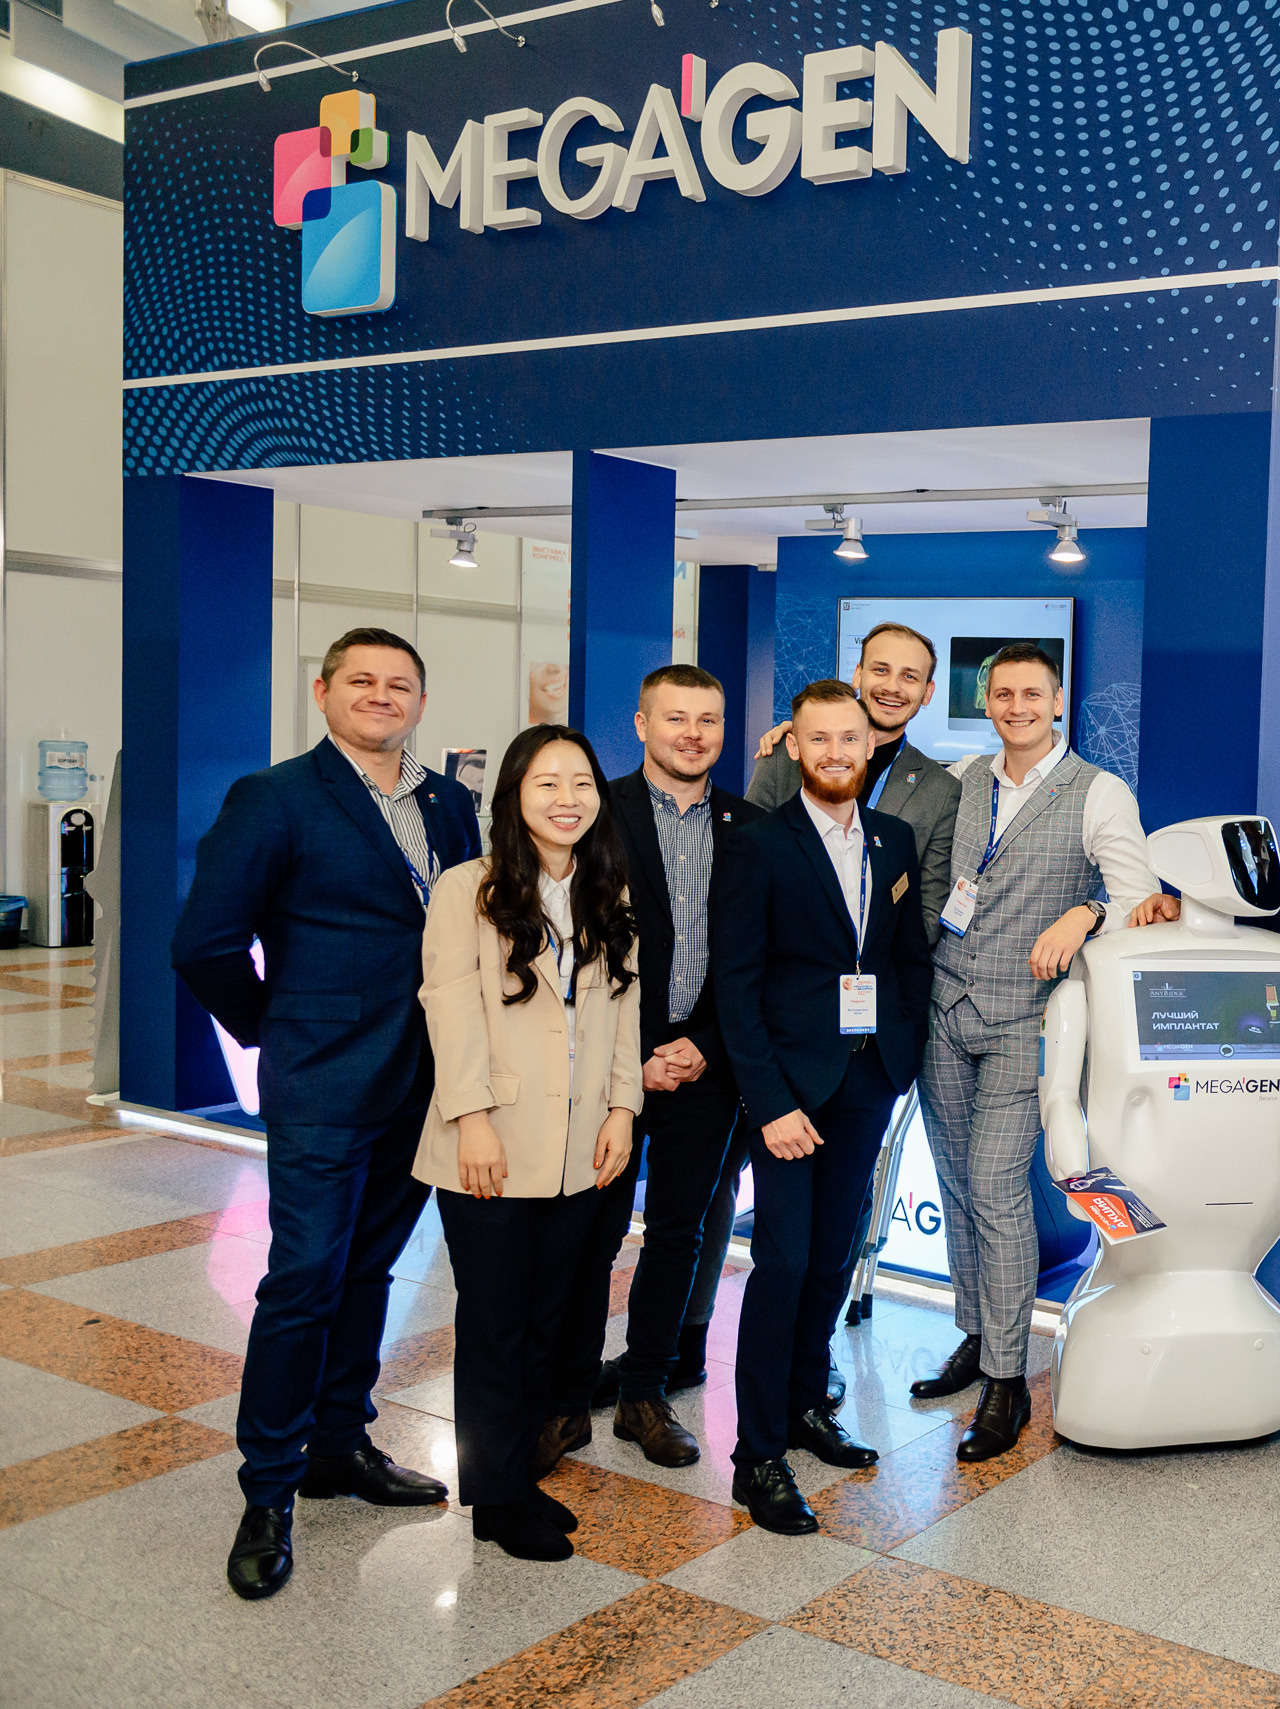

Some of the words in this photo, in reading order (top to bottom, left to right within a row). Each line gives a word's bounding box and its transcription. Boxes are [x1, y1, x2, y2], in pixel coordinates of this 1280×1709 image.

[1151, 1010, 1199, 1020] ЛУЧШИЙ
[1152, 1022, 1220, 1031] ИМПЛАНТАТ
[1092, 1197, 1129, 1229] АКЦИЯ
